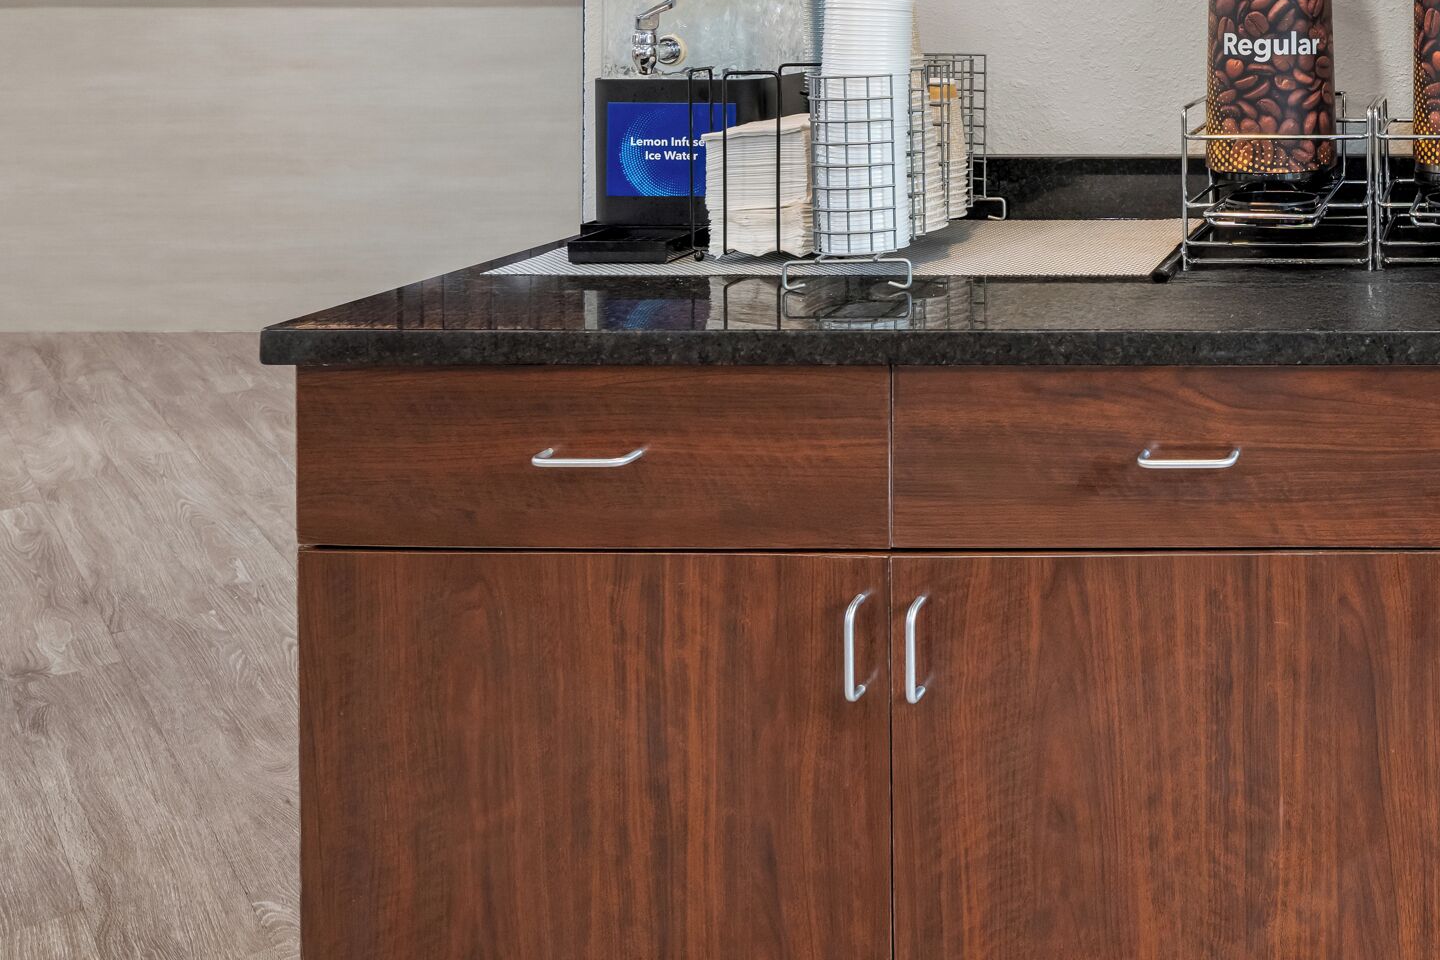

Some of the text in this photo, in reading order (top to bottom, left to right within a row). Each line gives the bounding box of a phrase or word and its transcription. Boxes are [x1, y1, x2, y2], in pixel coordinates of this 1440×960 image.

[1223, 30, 1320, 63] Regular
[630, 136, 668, 147] Lemon
[645, 150, 662, 160] Ice
